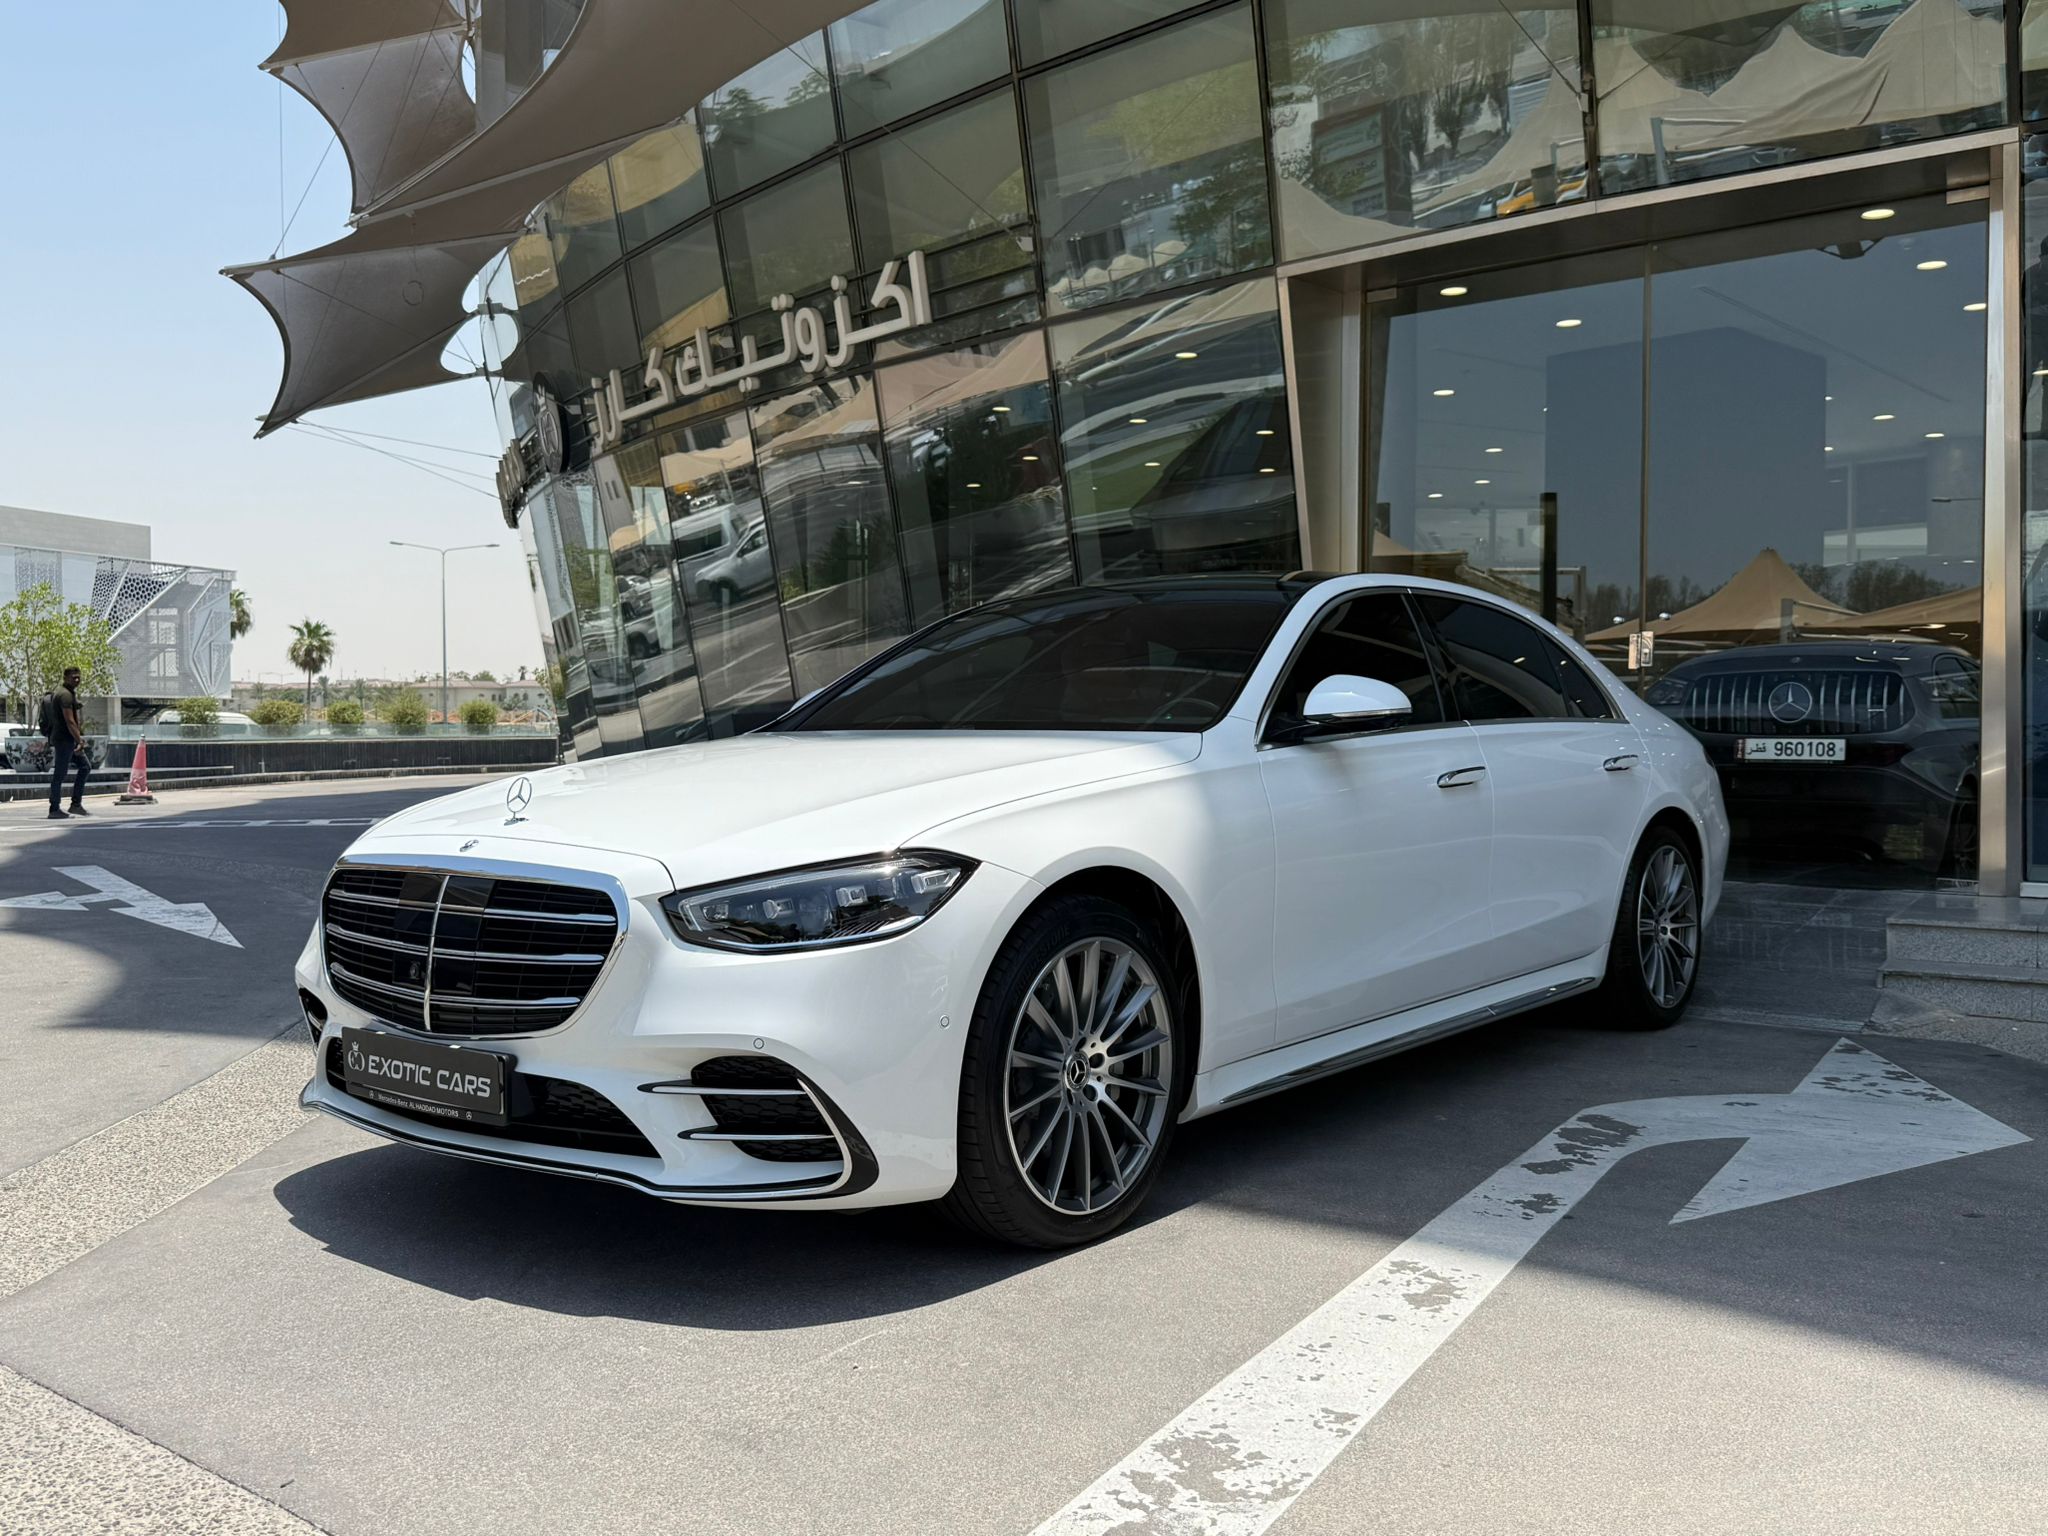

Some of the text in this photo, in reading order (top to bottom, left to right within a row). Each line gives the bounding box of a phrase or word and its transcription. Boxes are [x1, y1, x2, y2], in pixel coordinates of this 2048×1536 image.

[676, 250, 933, 393] اكزوتيك
[1746, 742, 1767, 755] قطر
[1774, 741, 1836, 757] 960108
[368, 1054, 491, 1098] EXOTIC CARS
[436, 1107, 459, 1118] MOTORS
